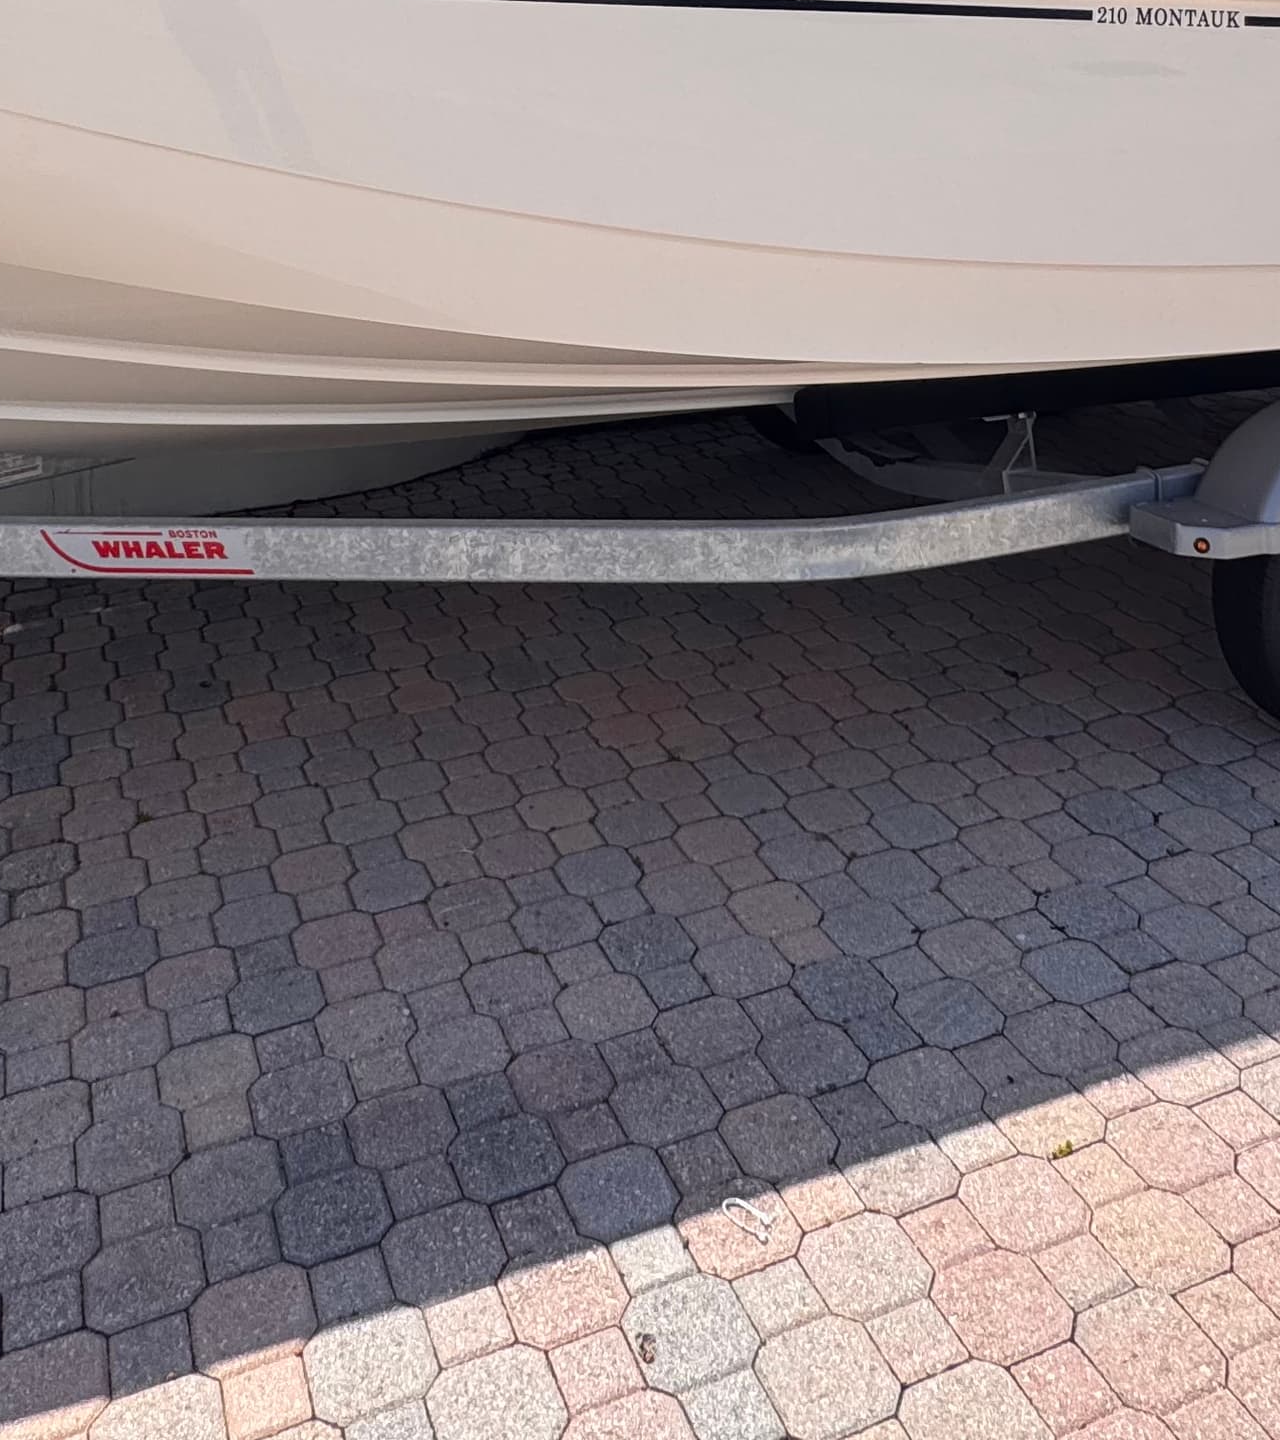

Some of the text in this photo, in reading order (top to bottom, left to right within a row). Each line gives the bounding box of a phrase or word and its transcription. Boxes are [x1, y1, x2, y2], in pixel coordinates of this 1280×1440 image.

[1097, 7, 1241, 29] 210 MONTAUK
[168, 529, 218, 540] BOSTON
[91, 540, 229, 560] WHALER
